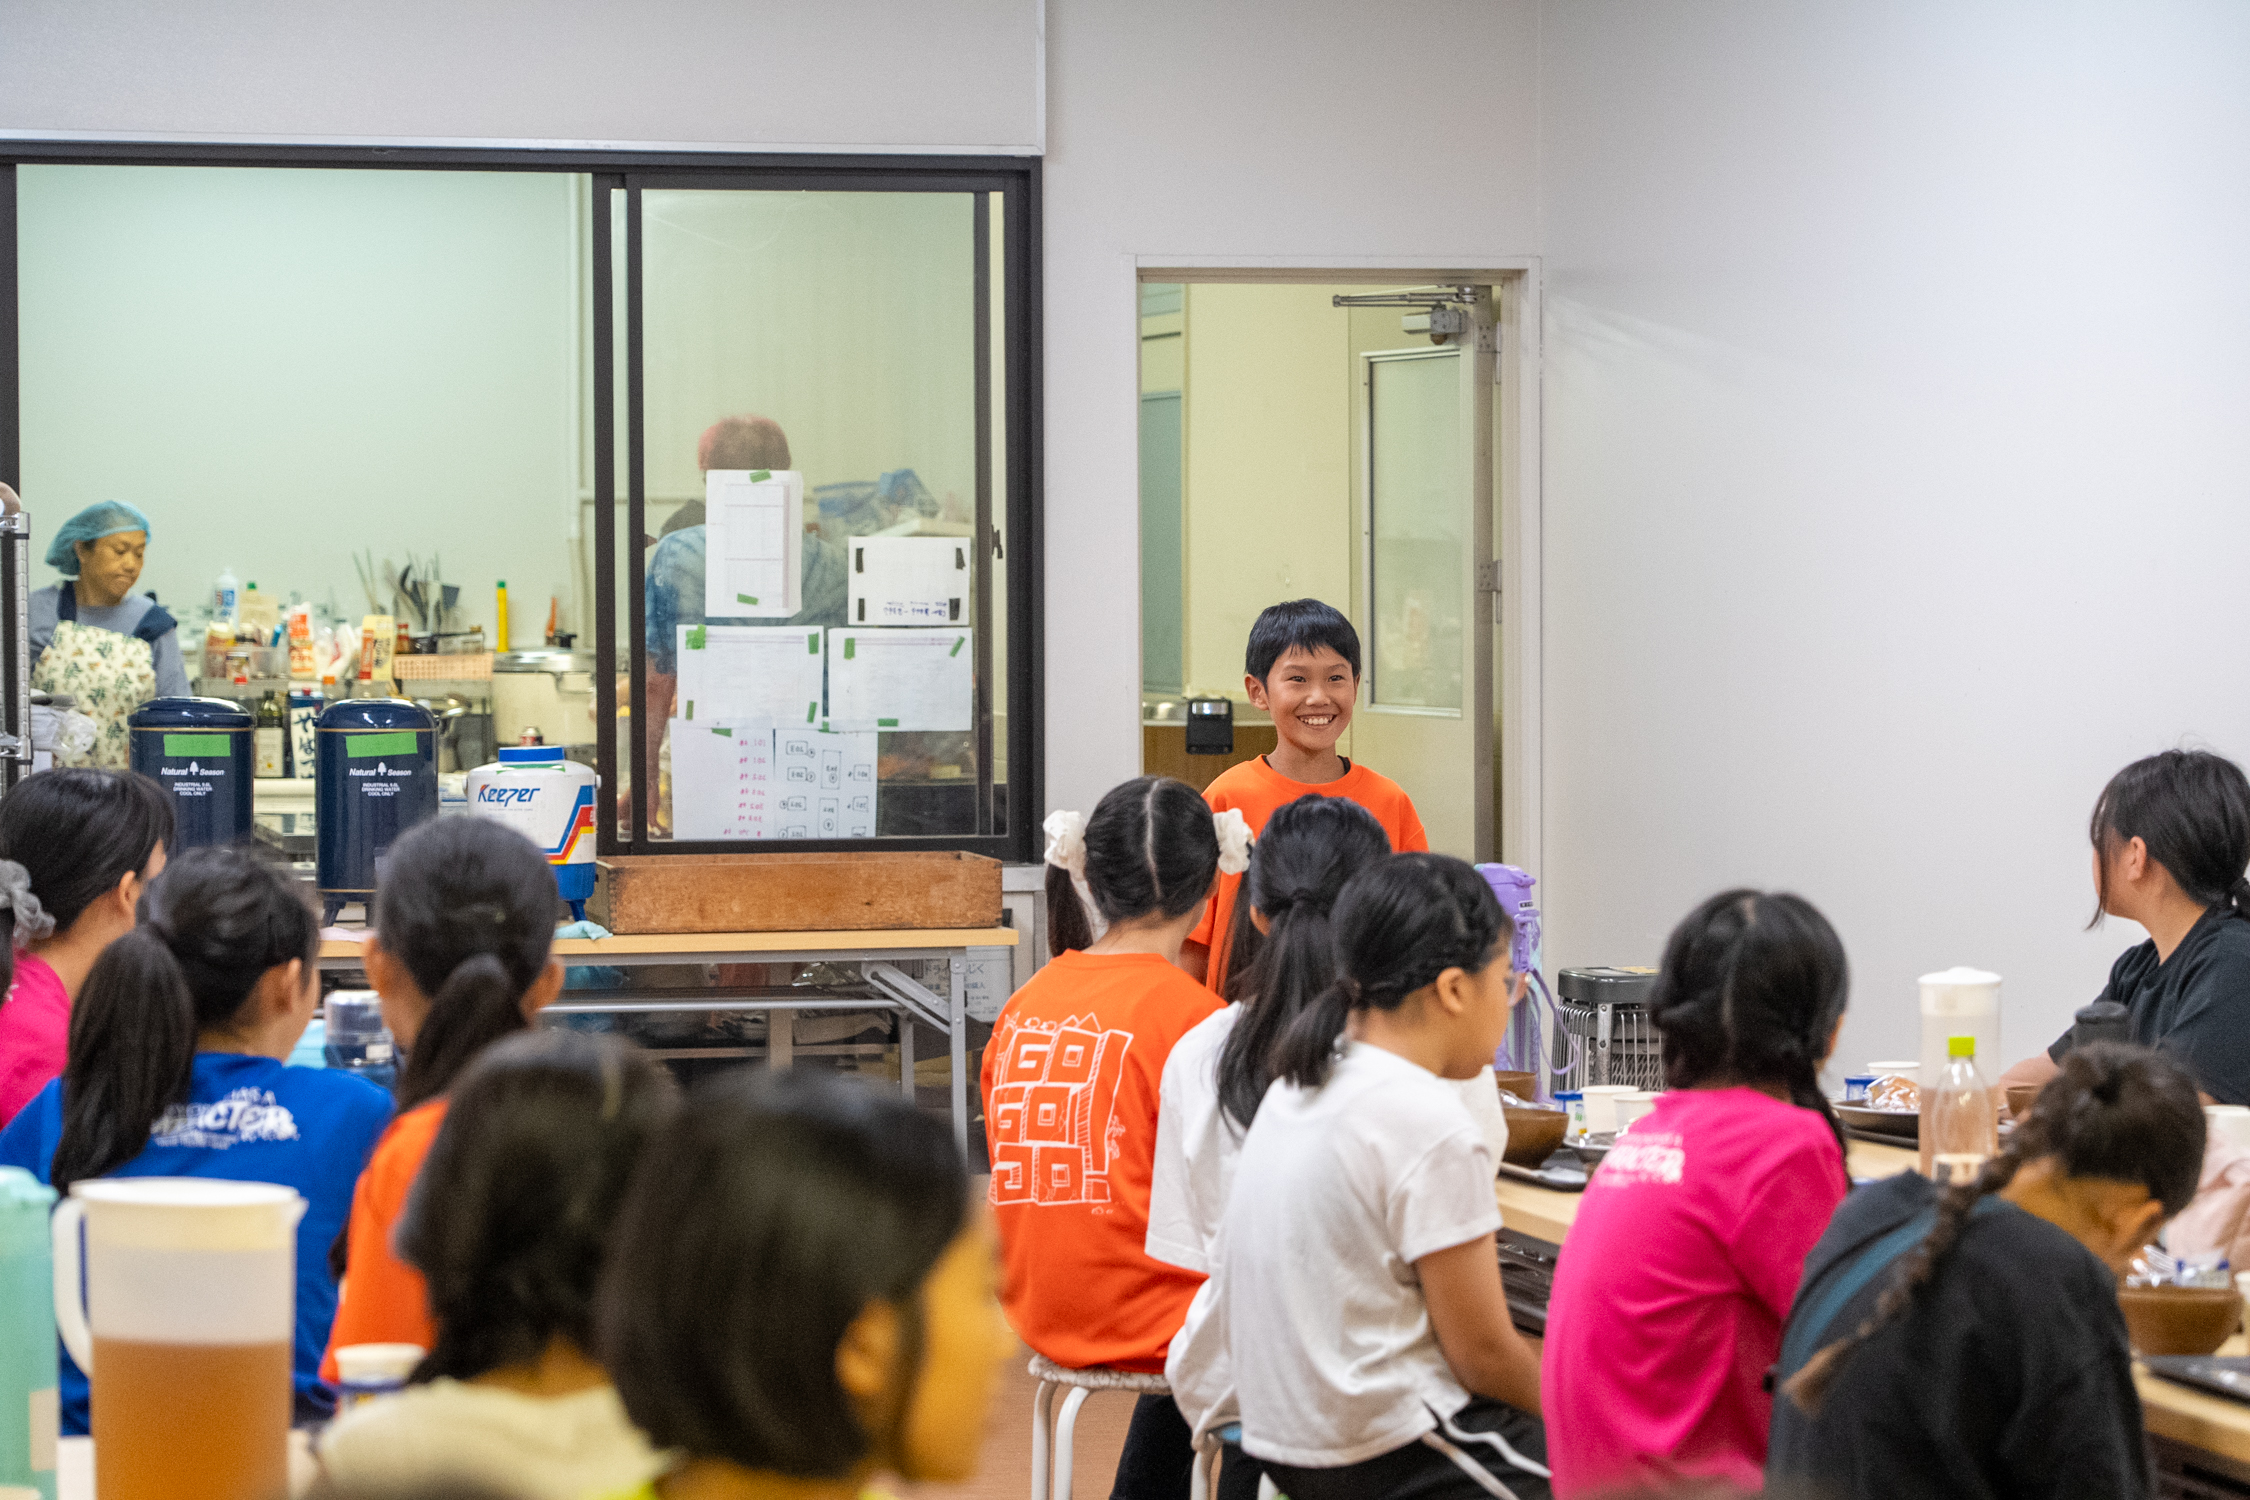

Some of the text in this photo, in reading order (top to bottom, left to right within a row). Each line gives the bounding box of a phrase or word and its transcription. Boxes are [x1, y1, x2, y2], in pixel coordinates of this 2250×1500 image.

[161, 767, 225, 776] Natural Season
[349, 768, 376, 776] Natural
